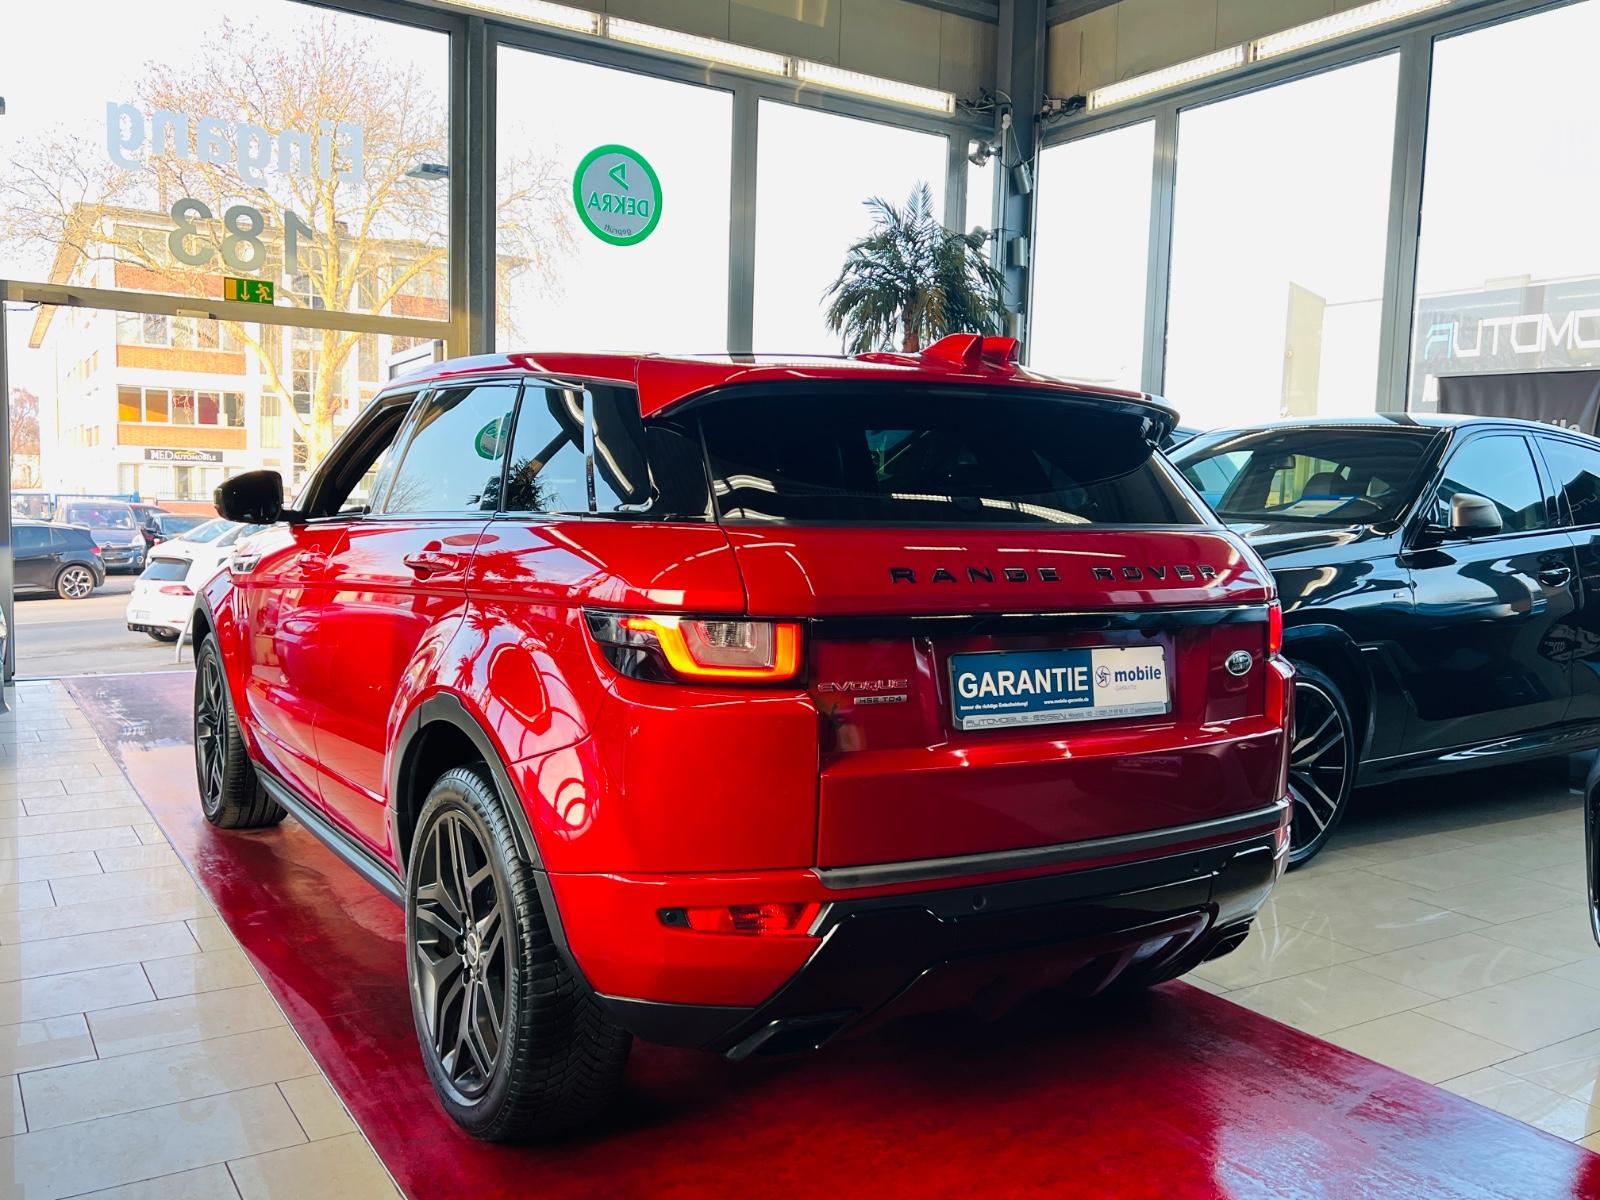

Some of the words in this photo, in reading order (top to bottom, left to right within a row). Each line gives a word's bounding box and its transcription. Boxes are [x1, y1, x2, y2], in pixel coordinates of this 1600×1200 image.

[150, 449, 174, 460] MED
[889, 566, 1062, 584] RANGE
[1092, 564, 1219, 582] ROVER
[1114, 665, 1162, 682] mobile
[817, 679, 908, 692] EVOQUE
[957, 666, 1089, 699] GARANTIE
